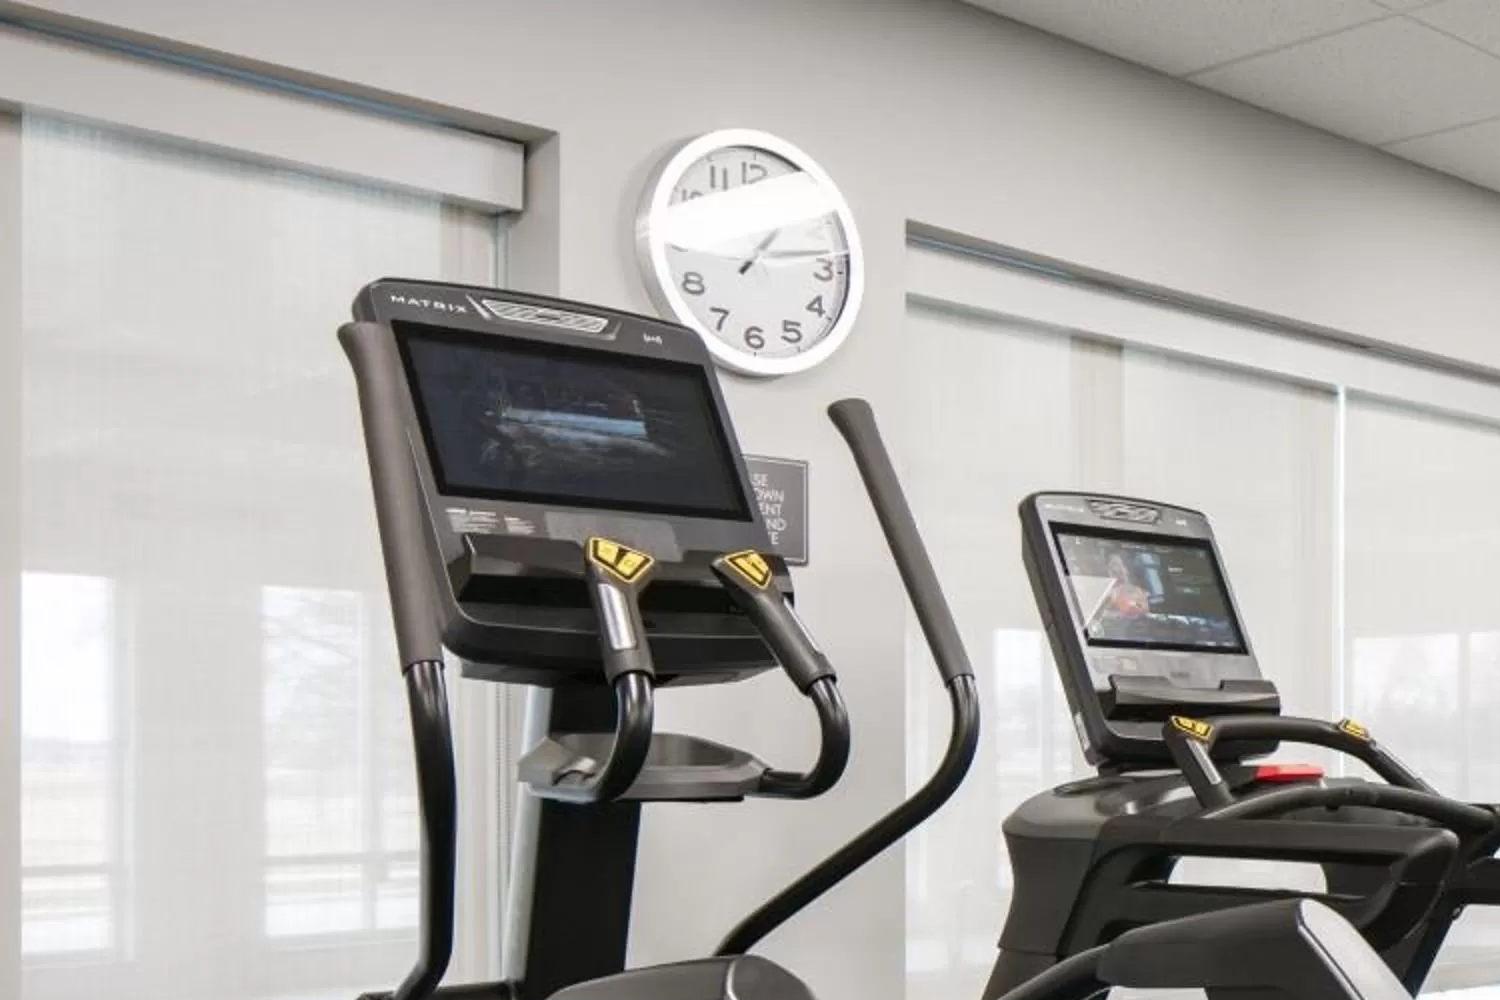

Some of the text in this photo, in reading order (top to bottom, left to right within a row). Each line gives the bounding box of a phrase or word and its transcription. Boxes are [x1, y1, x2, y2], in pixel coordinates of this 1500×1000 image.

[709, 164, 728, 190] 11
[813, 257, 834, 282] 3
[681, 271, 706, 296] 8
[390, 294, 467, 313] MATRIX
[805, 294, 827, 318] 4
[710, 306, 730, 332] 7
[781, 319, 804, 344] 5
[743, 325, 766, 350] 6
